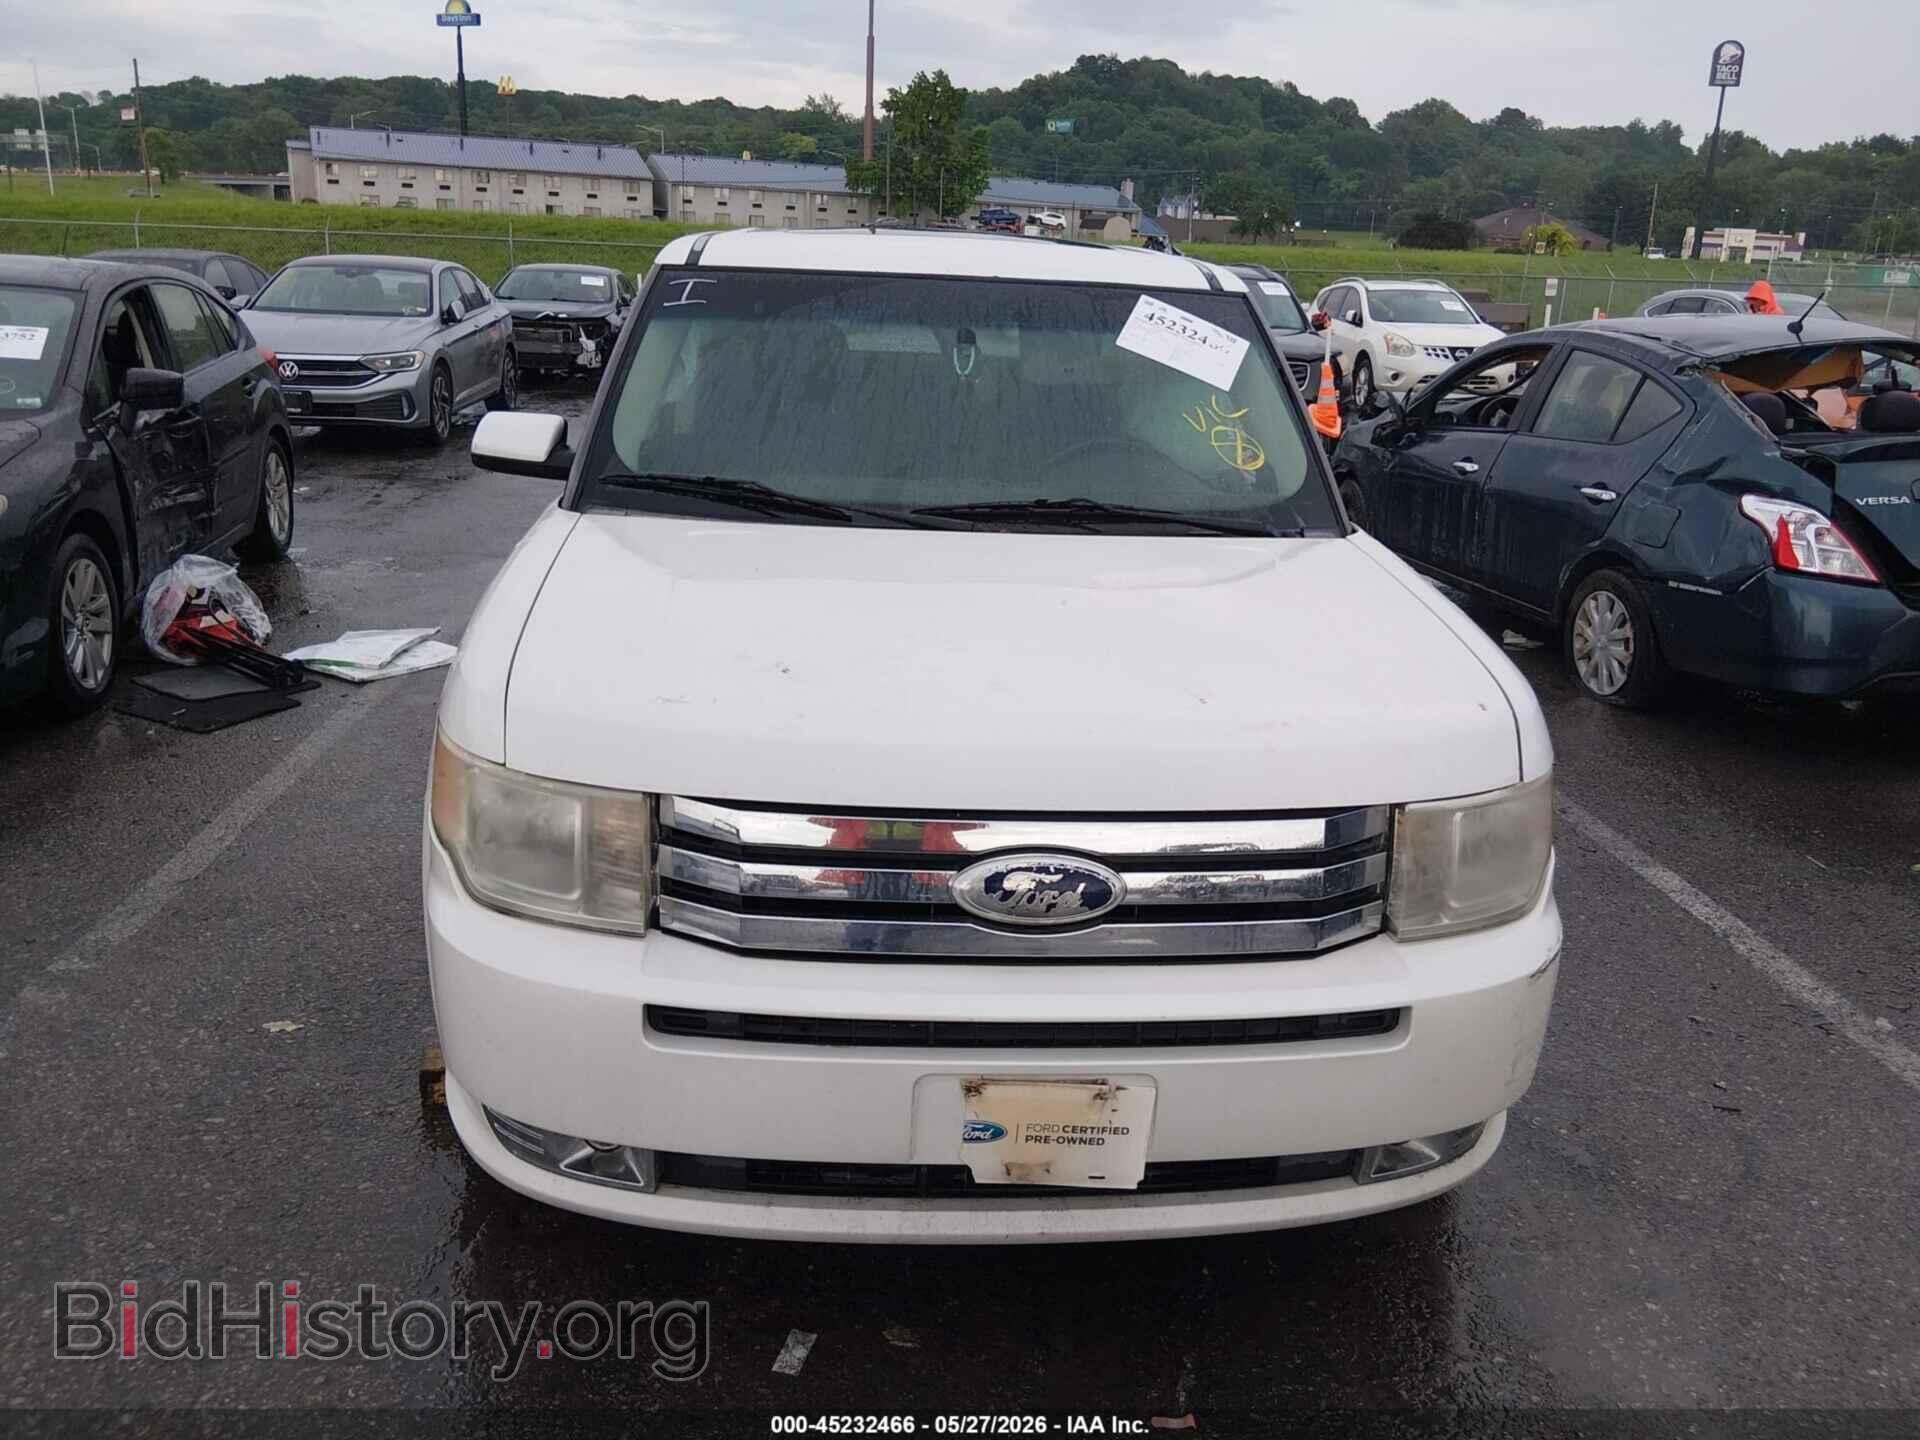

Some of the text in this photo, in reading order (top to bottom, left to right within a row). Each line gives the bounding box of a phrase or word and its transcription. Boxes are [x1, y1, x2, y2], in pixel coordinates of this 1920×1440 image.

[1716, 64, 1740, 72] TACO
[1715, 71, 1738, 80] BELL
[1855, 495, 1911, 505] VERSA
[993, 870, 1088, 914] Ford
[1026, 1123, 1130, 1136] FORD CERTIFIED
[1025, 1134, 1105, 1146] PRE-OWNED
